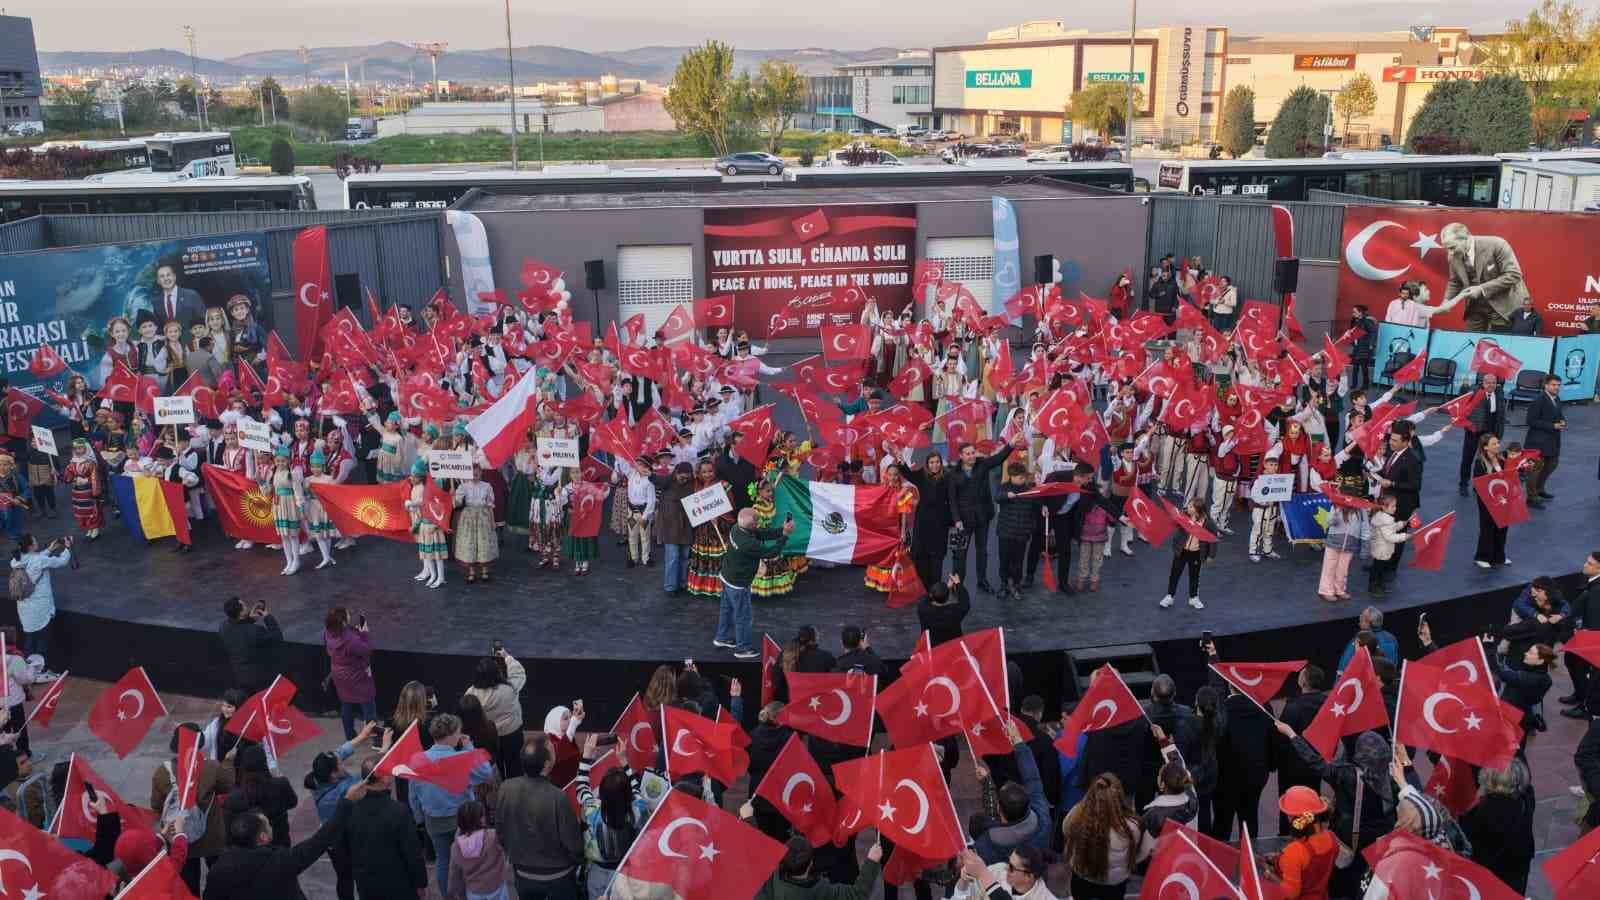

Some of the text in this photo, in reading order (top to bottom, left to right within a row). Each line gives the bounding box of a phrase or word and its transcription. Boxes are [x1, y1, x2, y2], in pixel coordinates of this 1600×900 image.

[975, 72, 1021, 86] BELLONA
[712, 243, 906, 267] YURTTA SULH, CİHANDA SULH
[712, 272, 908, 291] PEACE AT HOME, PEACE IN THE WORLD
